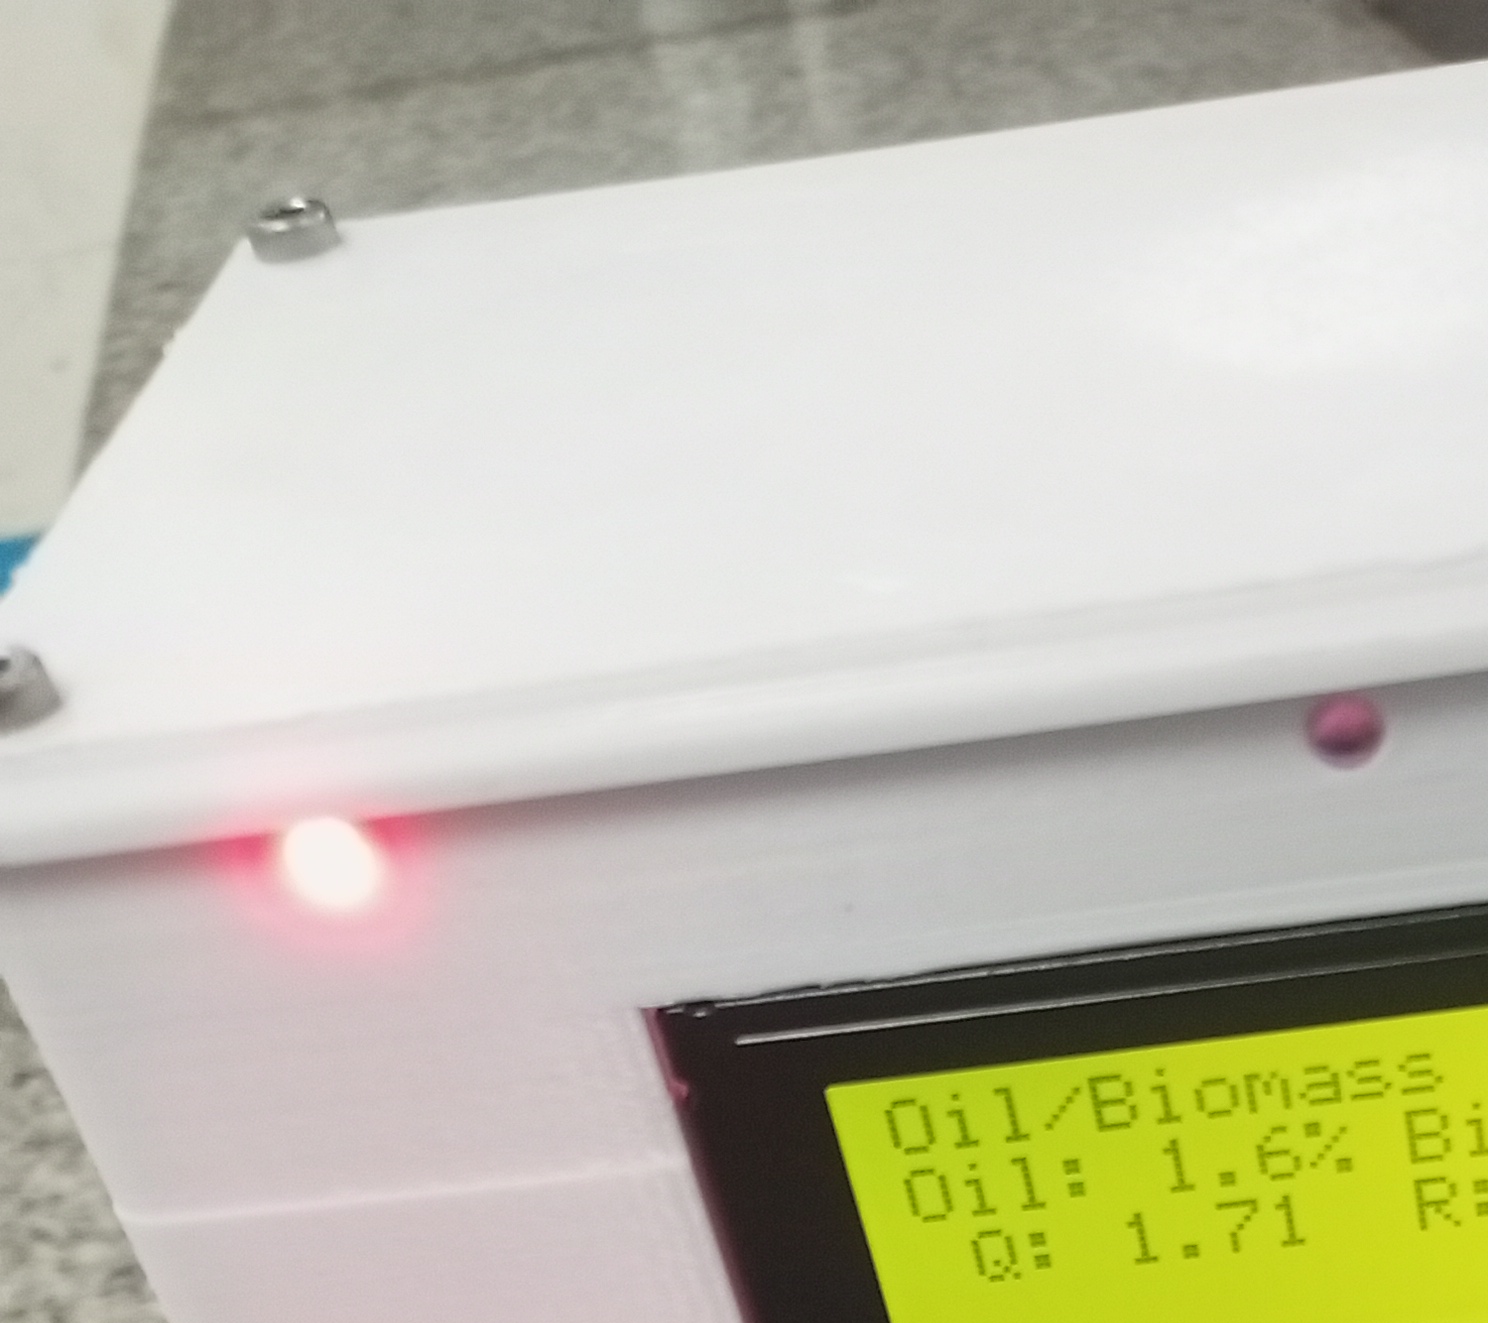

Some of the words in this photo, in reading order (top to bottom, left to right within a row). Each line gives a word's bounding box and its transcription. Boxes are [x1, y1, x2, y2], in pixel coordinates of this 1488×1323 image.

[885, 1052, 1445, 1154] Oil/Biomass
[903, 1157, 1085, 1222] Oil:
[1163, 1121, 1354, 1193] 1.6%
[972, 1229, 1053, 1283] Q:
[1127, 1195, 1306, 1264] 1.71
